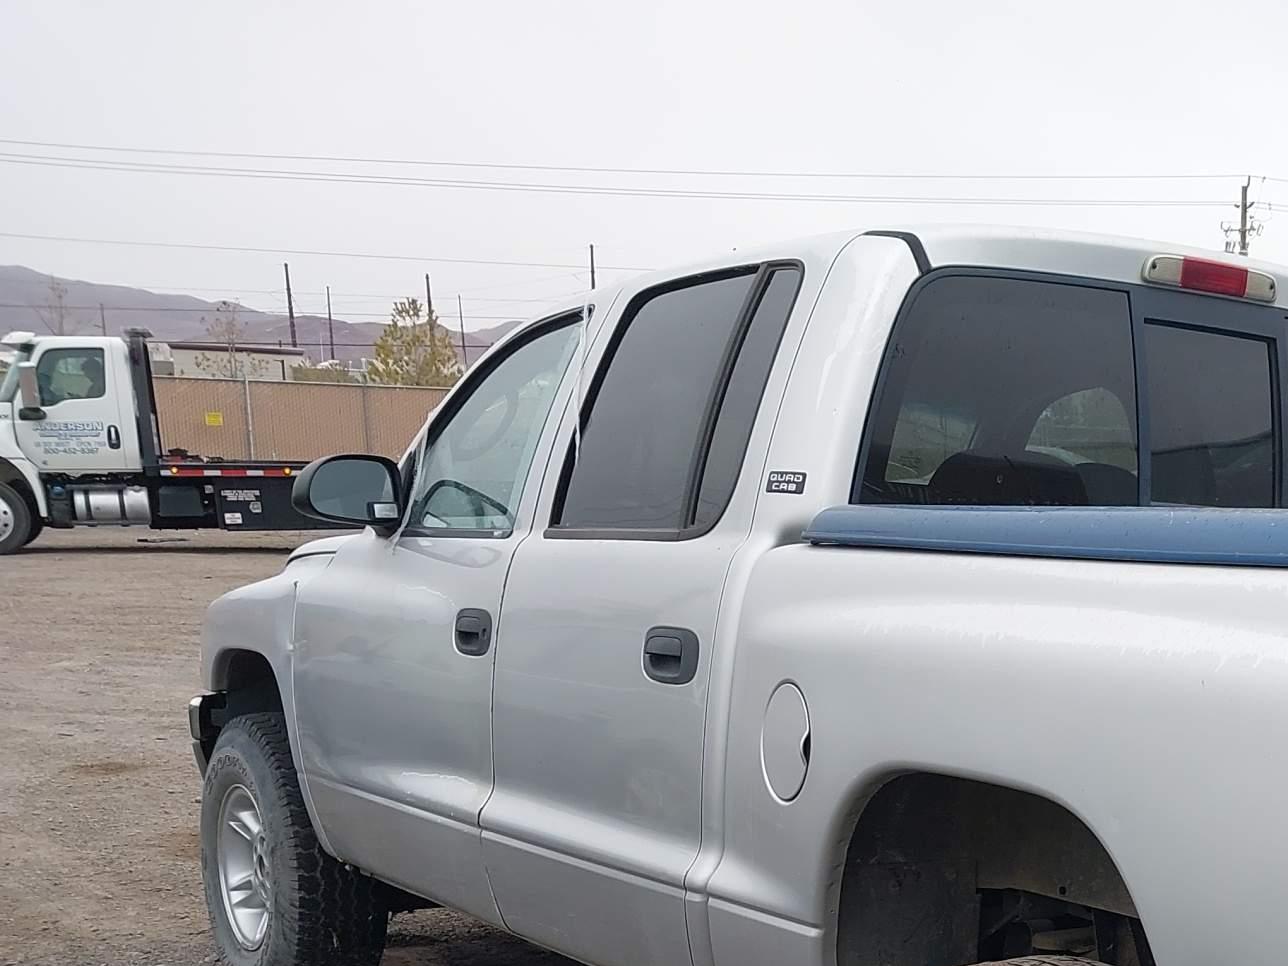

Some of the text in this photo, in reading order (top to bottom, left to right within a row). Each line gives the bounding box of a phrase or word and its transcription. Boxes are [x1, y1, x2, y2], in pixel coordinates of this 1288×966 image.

[32, 421, 103, 431] ANDERSON
[769, 473, 803, 482] QUAD
[771, 482, 797, 491] CAB
